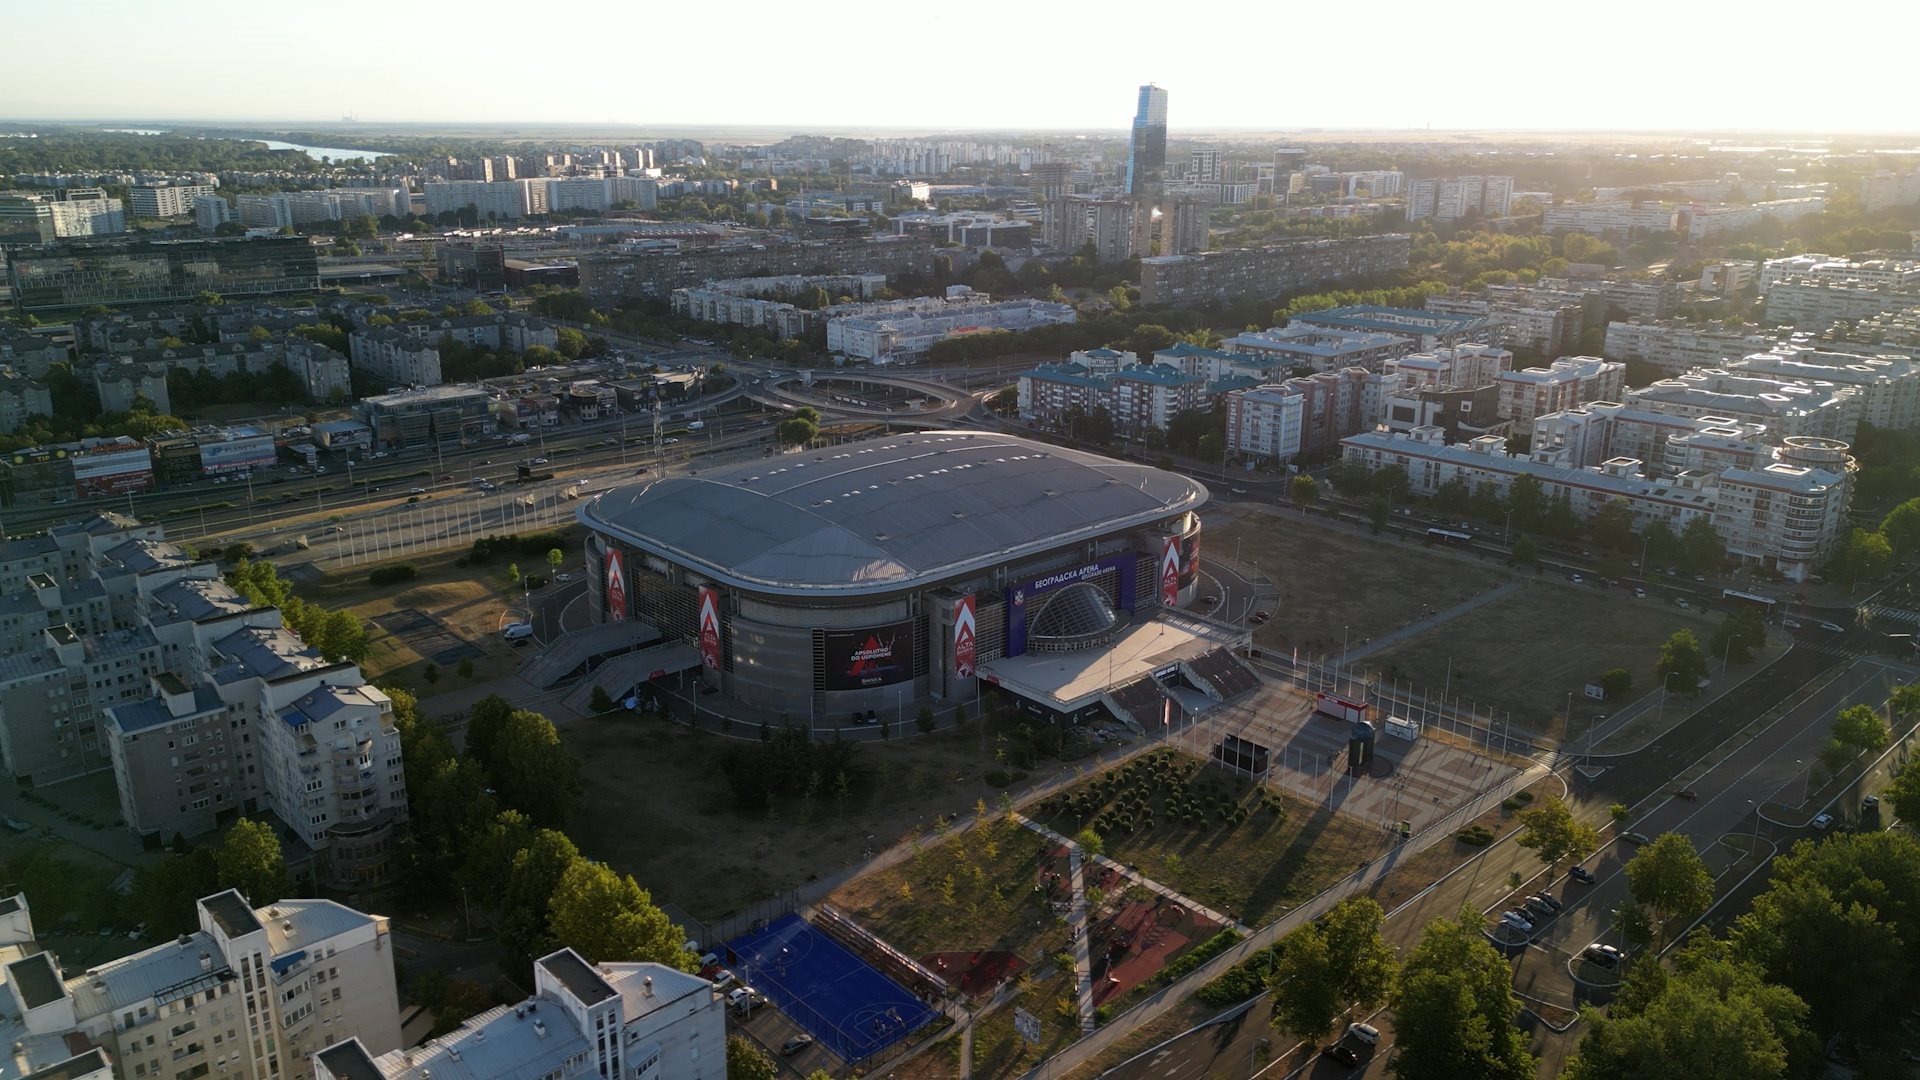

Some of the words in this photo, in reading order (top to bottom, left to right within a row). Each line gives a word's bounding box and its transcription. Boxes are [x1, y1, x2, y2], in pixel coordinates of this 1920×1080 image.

[1034, 570, 1078, 589] БЕОГРАДСКА
[1078, 563, 1099, 576] АРЕНА
[957, 641, 973, 650] ALTA
[861, 651, 892, 660] USPOMENE
[861, 676, 882, 684] BANKA
